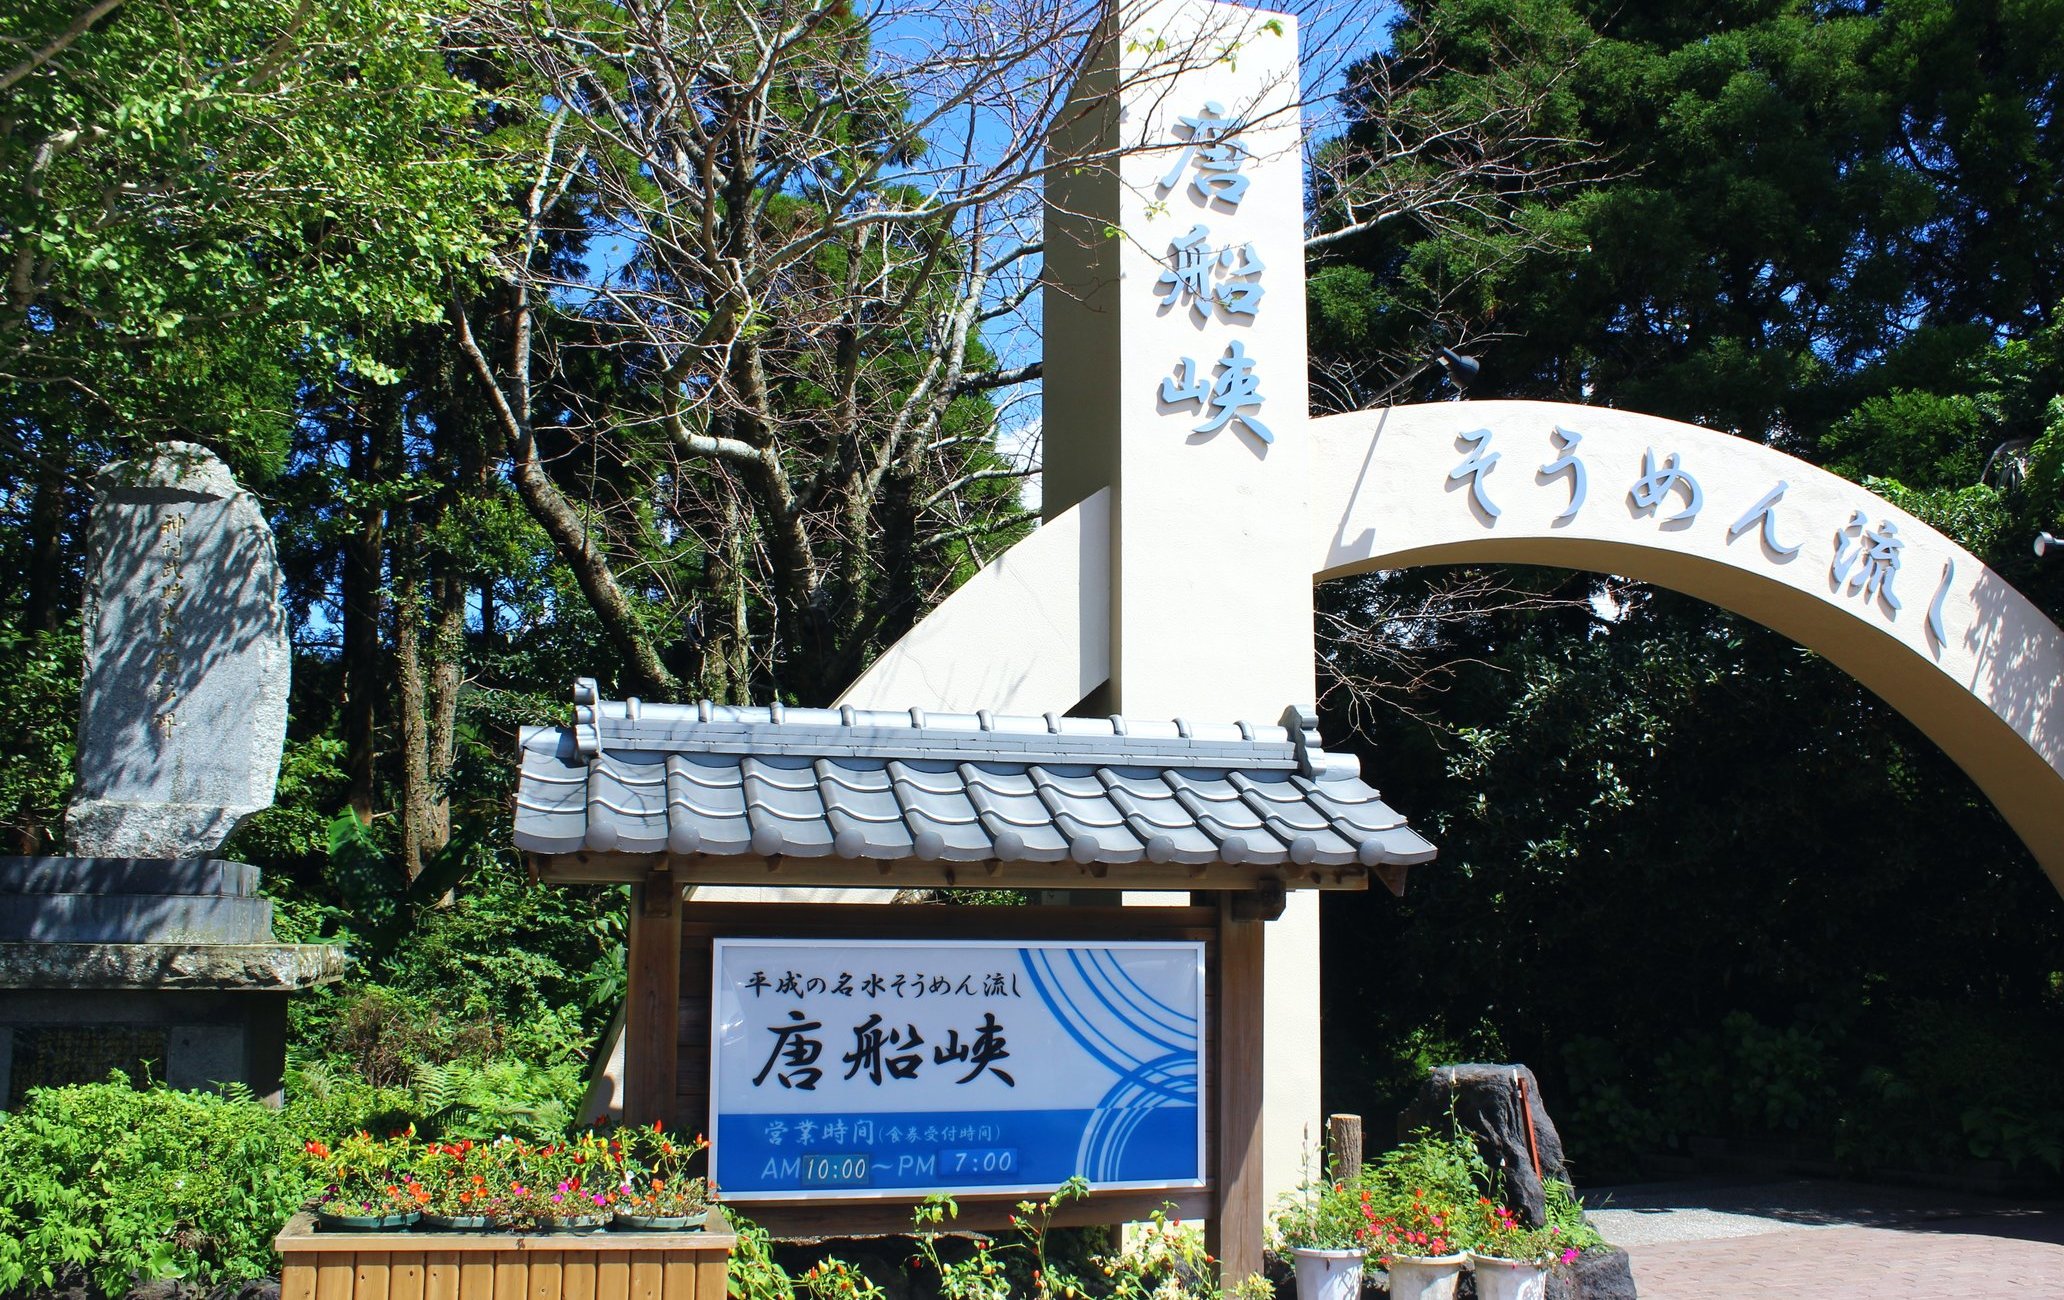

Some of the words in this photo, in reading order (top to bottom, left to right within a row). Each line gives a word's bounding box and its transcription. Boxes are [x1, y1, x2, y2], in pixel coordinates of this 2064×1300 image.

[1157, 101, 1275, 445] 唐船峡
[1449, 425, 1955, 648] そうめん流し
[744, 970, 1022, 999] 平成の名水そうめん流し
[752, 1010, 1016, 1091] 唐船峡
[807, 1157, 867, 1181] 10:00
[954, 1151, 1012, 1173] 7:00
